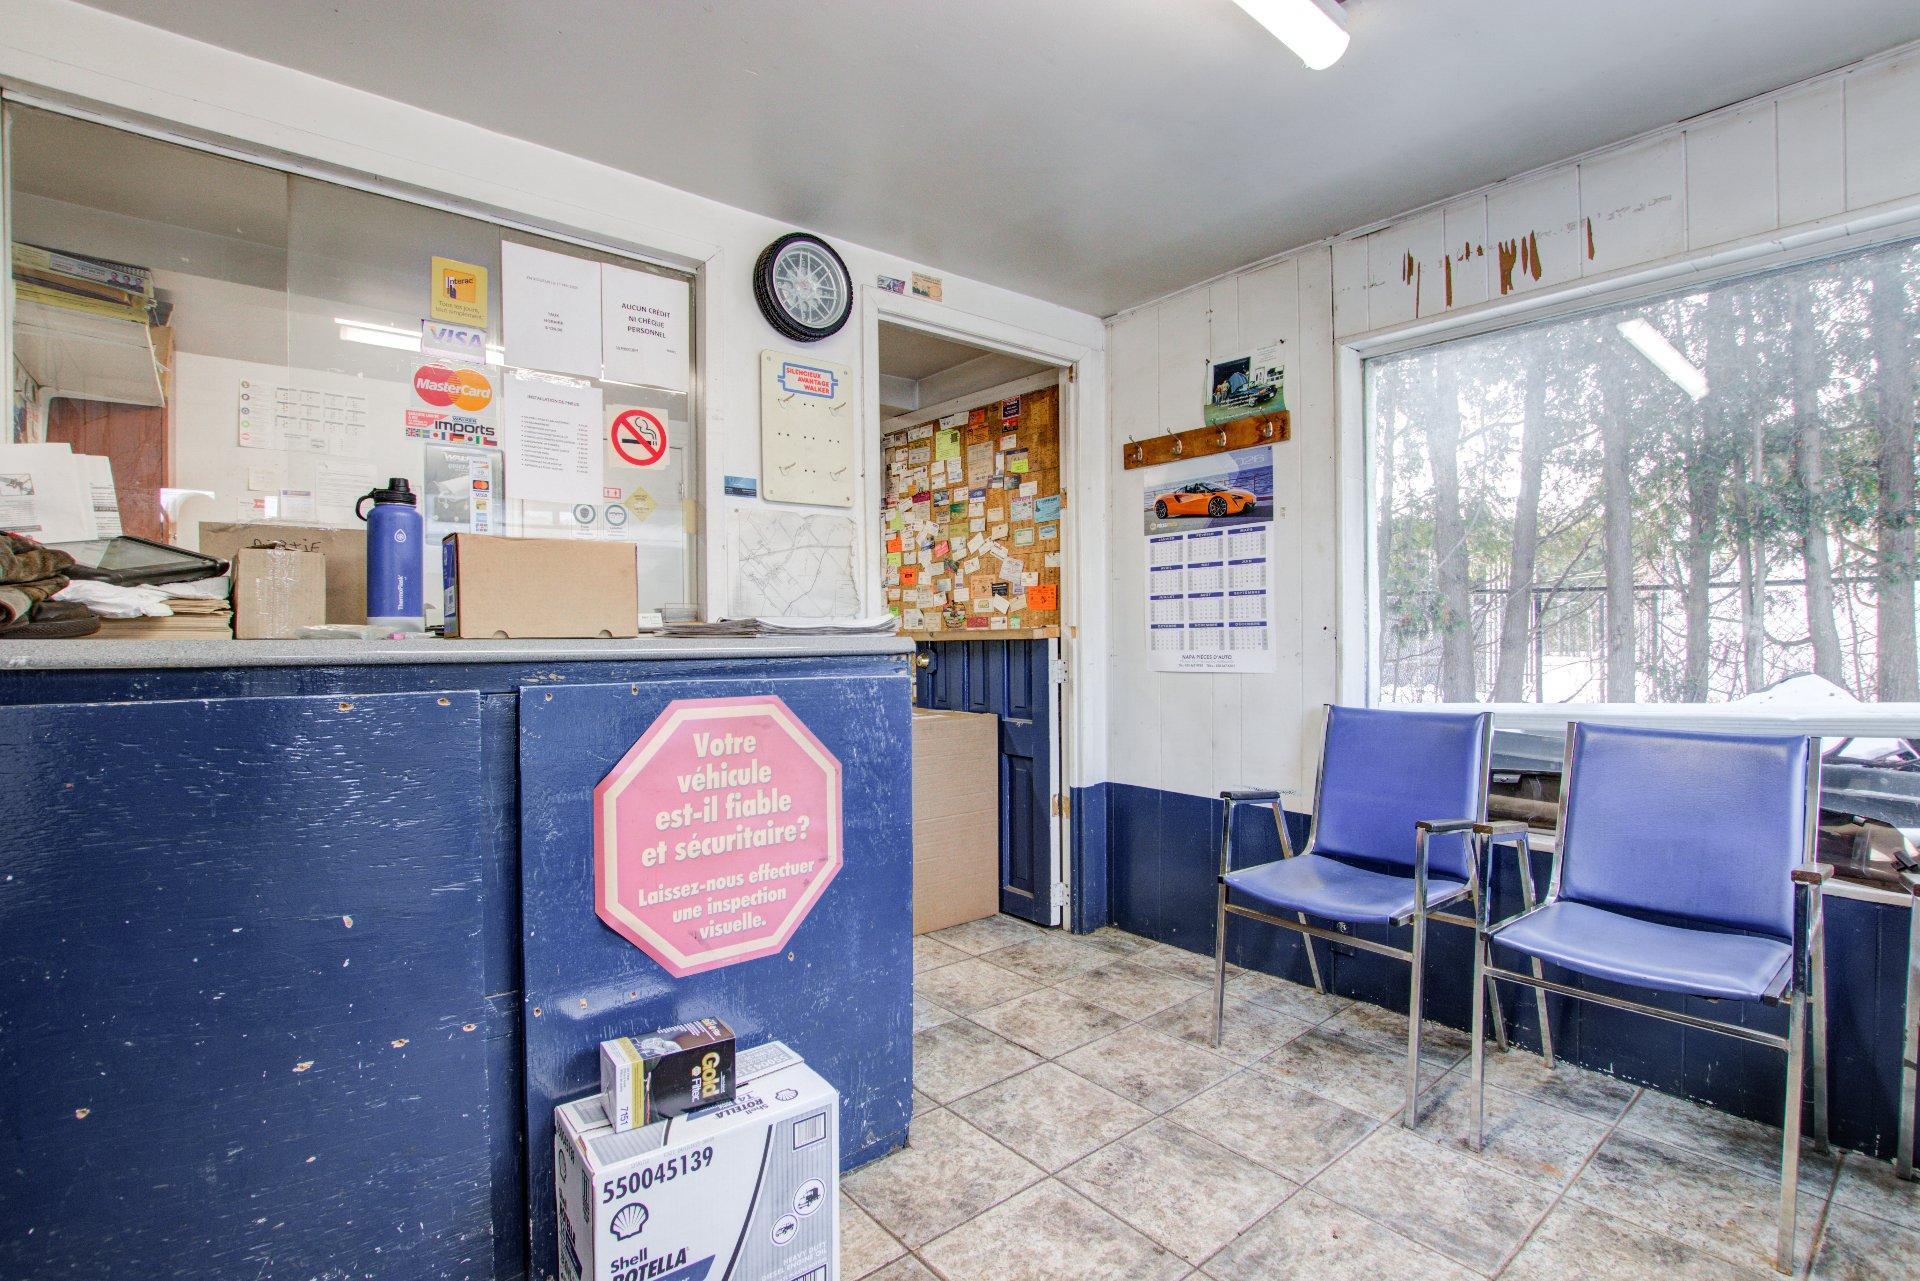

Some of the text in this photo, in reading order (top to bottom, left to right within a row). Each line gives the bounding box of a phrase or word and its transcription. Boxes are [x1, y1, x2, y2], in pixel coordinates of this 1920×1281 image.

[447, 276, 474, 288] Interac
[621, 302, 671, 318] AUCUN CRÉDIT
[628, 315, 637, 323] NI
[429, 324, 482, 347] VISA
[627, 325, 667, 339] PERSONNEL
[786, 367, 822, 379] SILENCIEUX
[797, 376, 830, 387] AVANTAGE
[415, 377, 491, 399] MasterCard
[804, 384, 830, 394] WALKER
[434, 420, 495, 437] imports
[692, 732, 757, 759] Votre
[676, 758, 772, 794] véhicule
[655, 787, 793, 831] est-il fiable
[641, 814, 811, 868] et sécuritaire?
[638, 858, 816, 908] Laissez-nous effectuer
[672, 886, 787, 924] une inspection
[699, 910, 767, 941] visuelle.
[701, 1052, 720, 1099] Gold
[715, 1098, 765, 1119] ROTELLA
[602, 1146, 714, 1204] 550045139
[610, 1246, 648, 1274] Shell
